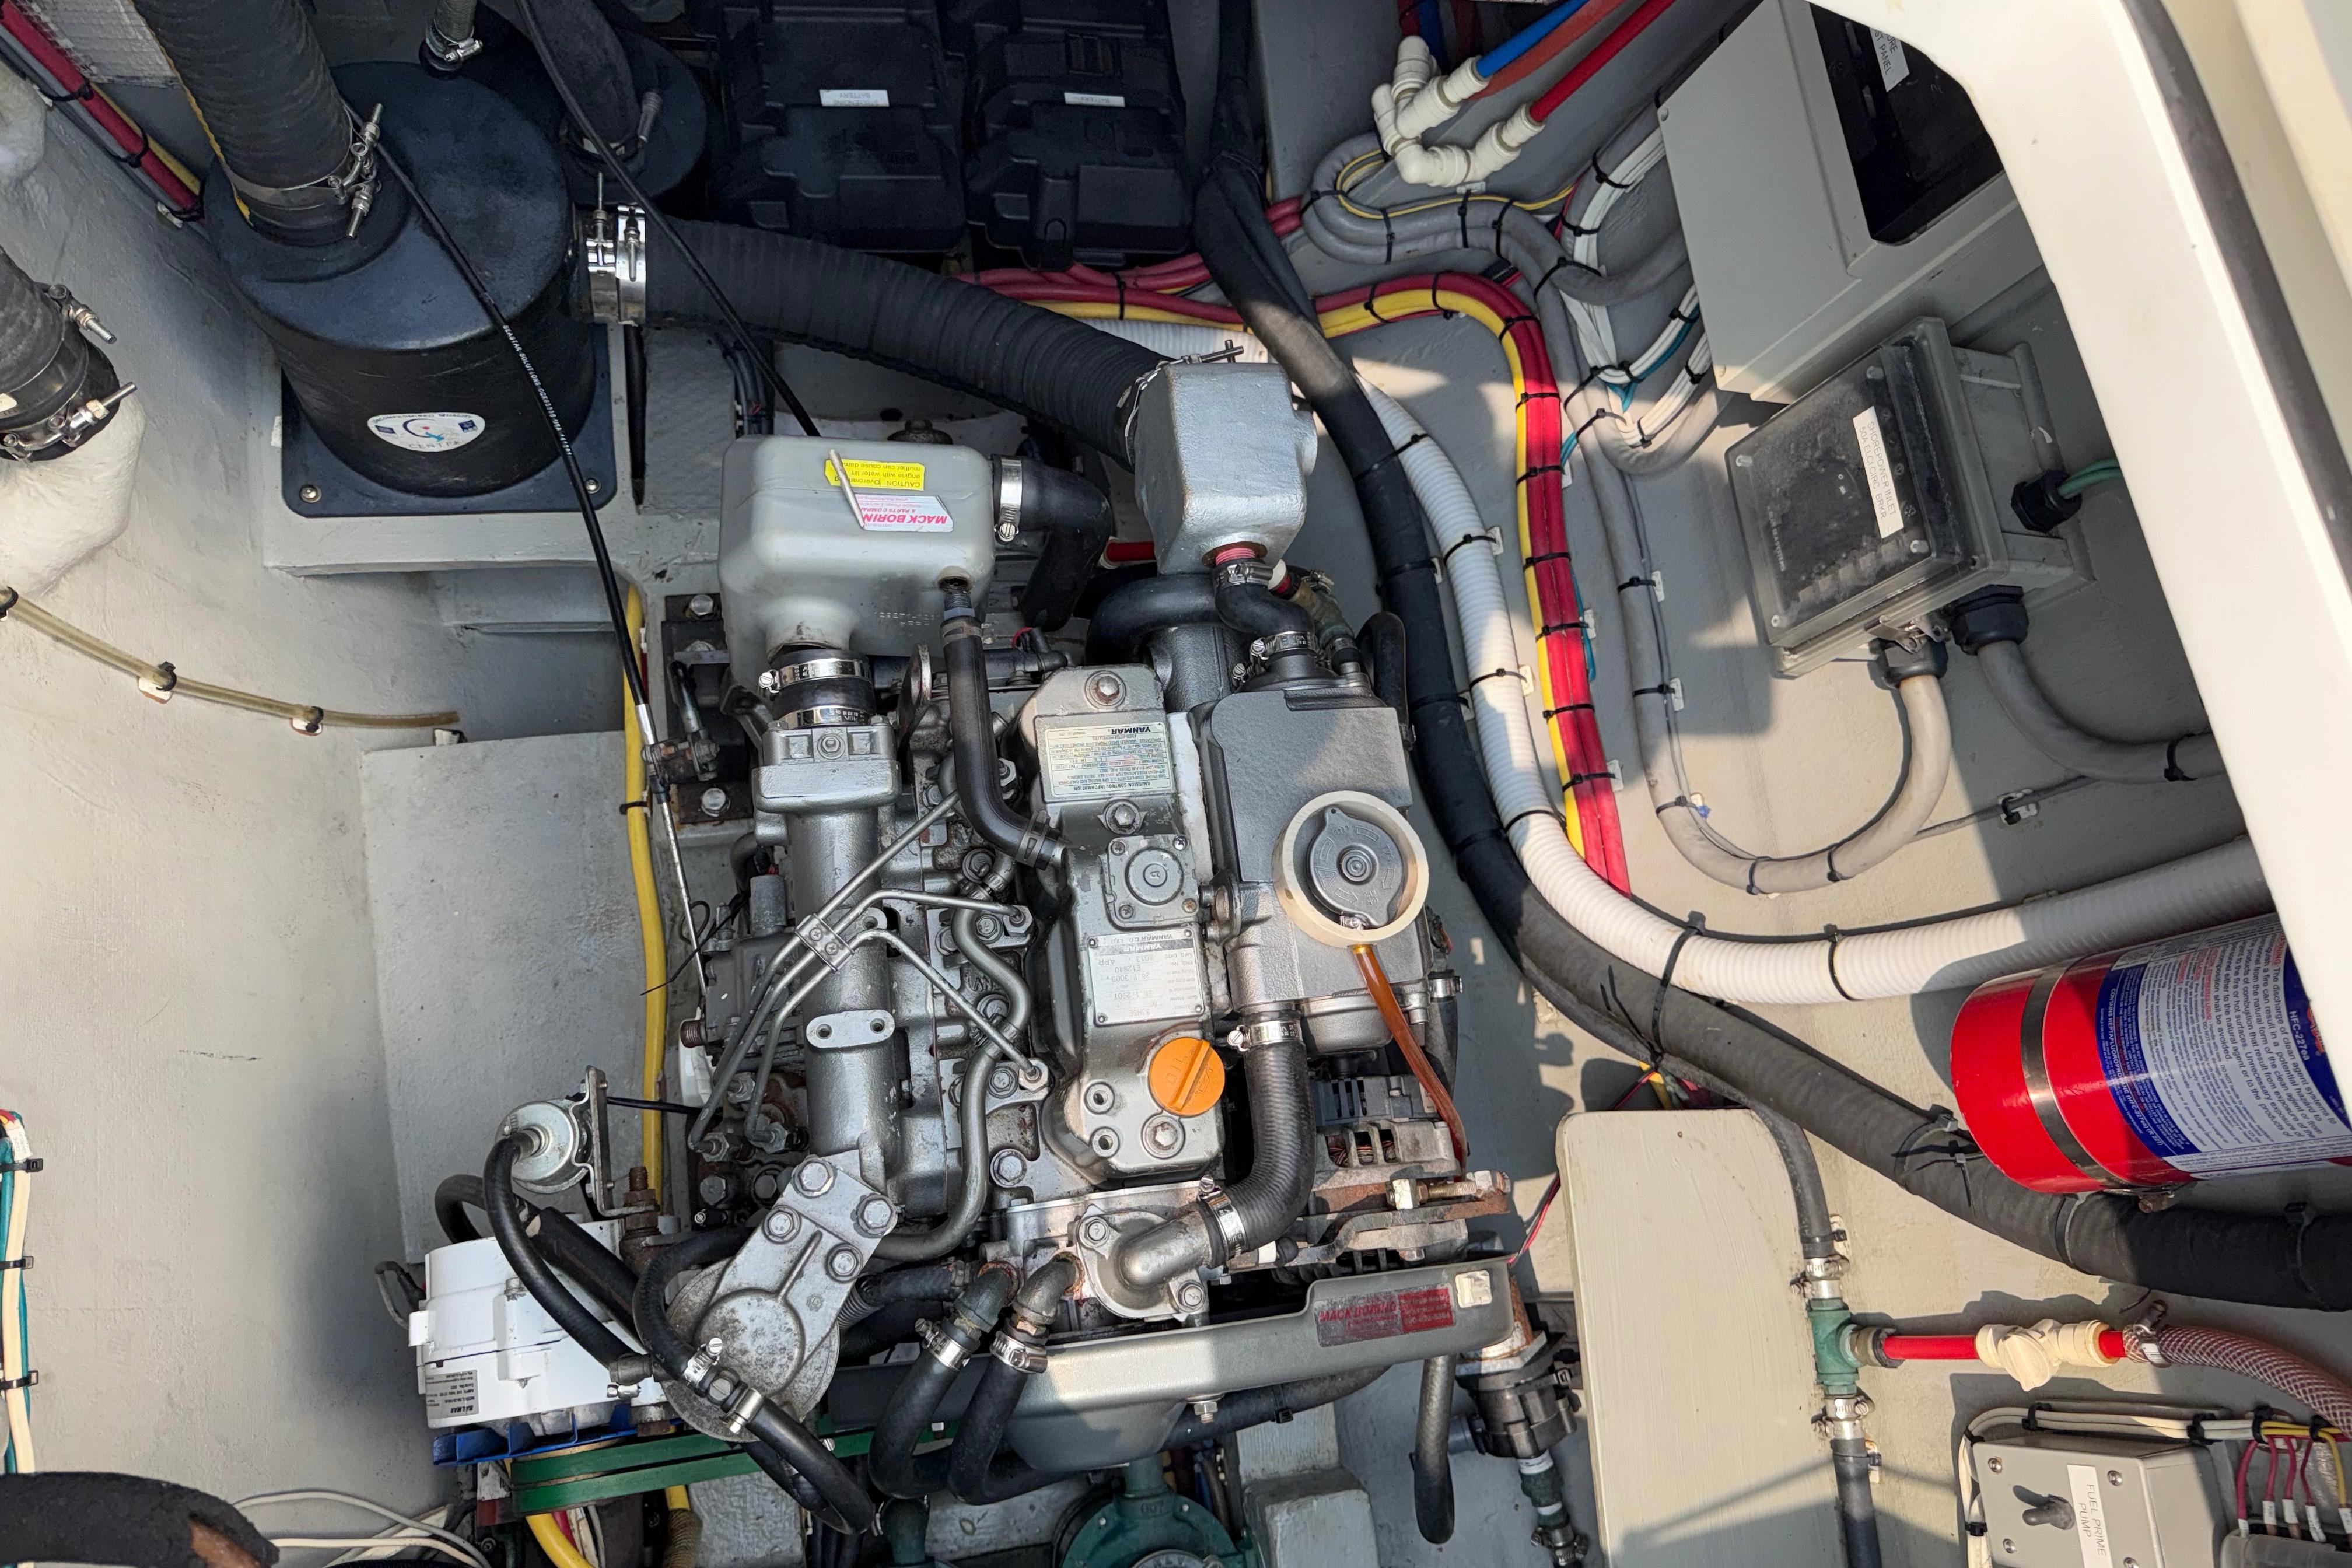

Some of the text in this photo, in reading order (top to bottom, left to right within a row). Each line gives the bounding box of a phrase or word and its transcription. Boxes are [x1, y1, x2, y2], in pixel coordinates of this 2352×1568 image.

[1877, 44, 1893, 75] PANEL
[502, 323, 522, 352] SEASTAR
[518, 351, 541, 387] SOLUTIONS
[897, 471, 920, 480] engine
[1858, 426, 1888, 519] 50A ELCI CIRC BRKR
[1866, 421, 1896, 515] SHOREPOWER INLET
[862, 513, 947, 524] MACK BORIN
[1110, 725, 1151, 735] YANMAR
[1123, 942, 1162, 953] YANMAR
[1141, 933, 1173, 942] YANMAR
[2233, 965, 2241, 976] the
[2242, 949, 2253, 976] products
[2222, 973, 2231, 992] either
[2232, 977, 2241, 989] fire
[2260, 975, 2269, 987] fire
[2232, 1000, 2241, 1013] hot
[2261, 989, 2270, 1004] can
[2222, 1003, 2231, 1016] the
[2241, 986, 2256, 1030] combustion
[2262, 1006, 2276, 1030] result
[2211, 994, 2232, 1062] shall be avoided.
[2224, 1017, 2238, 1045] natural
[2269, 1030, 2278, 1040] in
[2248, 1031, 2259, 1047] that
[2269, 968, 2337, 1126] The discharge of clean agent systems to
[2106, 1017, 2130, 1094] HEPTAFLUOROPROANE
[2230, 1045, 2246, 1069] agent
[2252, 967, 2323, 1136] from the natural form of the clean agent or from
[2252, 1047, 2269, 1071] result
[2241, 1068, 2250, 1079] or
[2243, 1051, 2274, 1102] Unnecessary
[2274, 1049, 2300, 1087] potential
[2245, 1078, 2255, 1088] to
[2263, 1070, 2278, 1090] from
[2249, 1087, 2262, 1101] the
[2293, 1086, 2316, 1115] hazard
[2272, 1088, 2300, 1124] exposure
[2258, 1101, 2284, 1132] products
[2268, 1100, 2297, 1133] exposure
[2296, 1120, 2308, 1131] of
[2312, 1112, 2323, 1123] to
[2292, 1129, 2305, 1140] of
[2303, 1128, 2315, 1140] the
[1318, 1308, 1352, 1323] MACK
[2077, 1501, 2092, 1538] PUMP
[2085, 1482, 2107, 1558] FUEL PRIME
